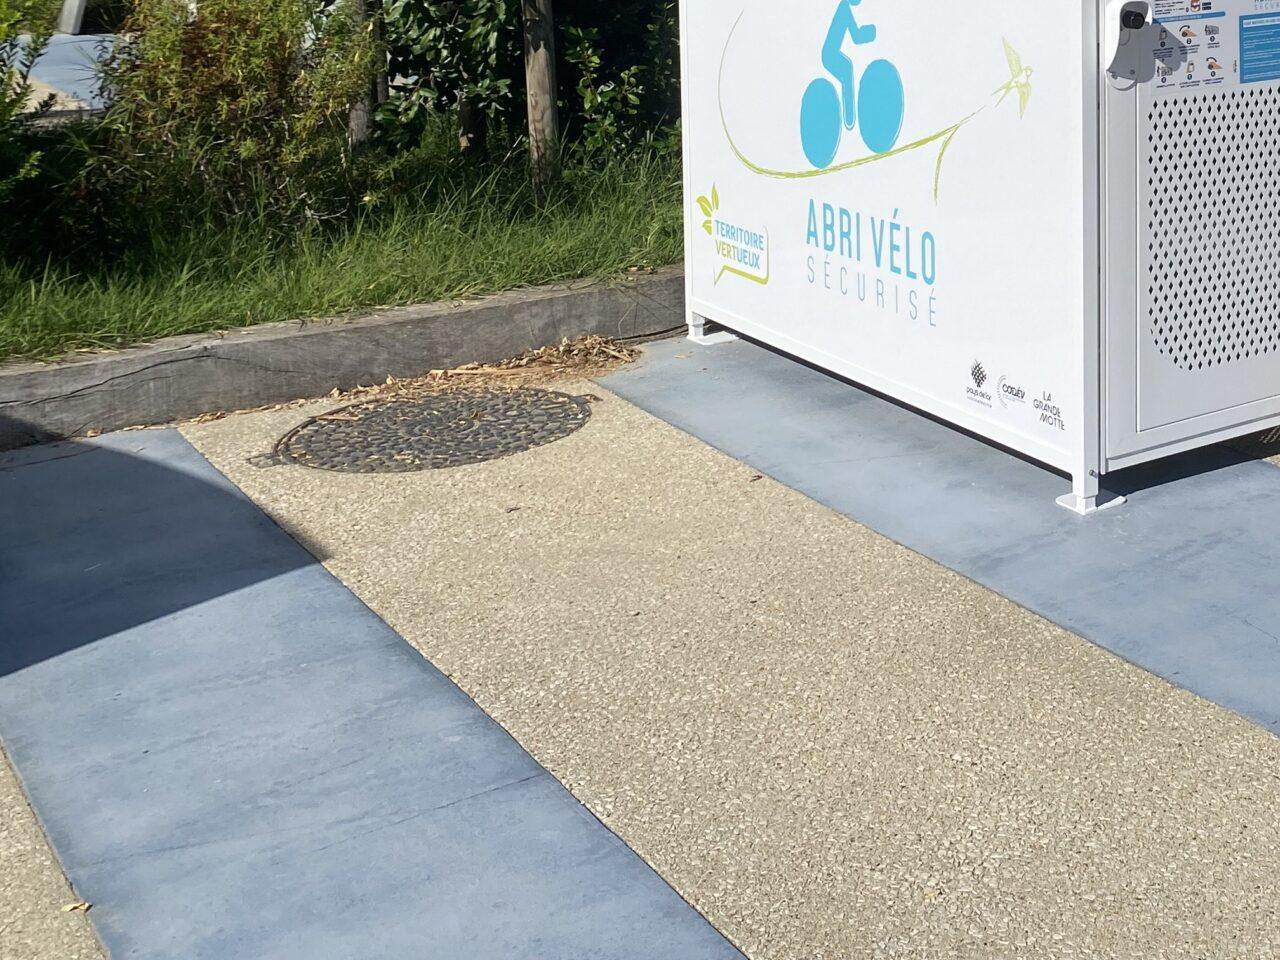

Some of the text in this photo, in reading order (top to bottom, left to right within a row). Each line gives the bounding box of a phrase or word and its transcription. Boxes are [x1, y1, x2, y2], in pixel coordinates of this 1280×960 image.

[715, 220, 764, 251] TERRITOIRE
[806, 198, 936, 285] ABRI VÉLO
[715, 240, 760, 270] VERTUEUX
[807, 255, 937, 327] SÉCURISÉ
[1033, 399, 1061, 417] GRANDE
[1043, 391, 1051, 401] LA
[1040, 413, 1064, 430] MOTTE
